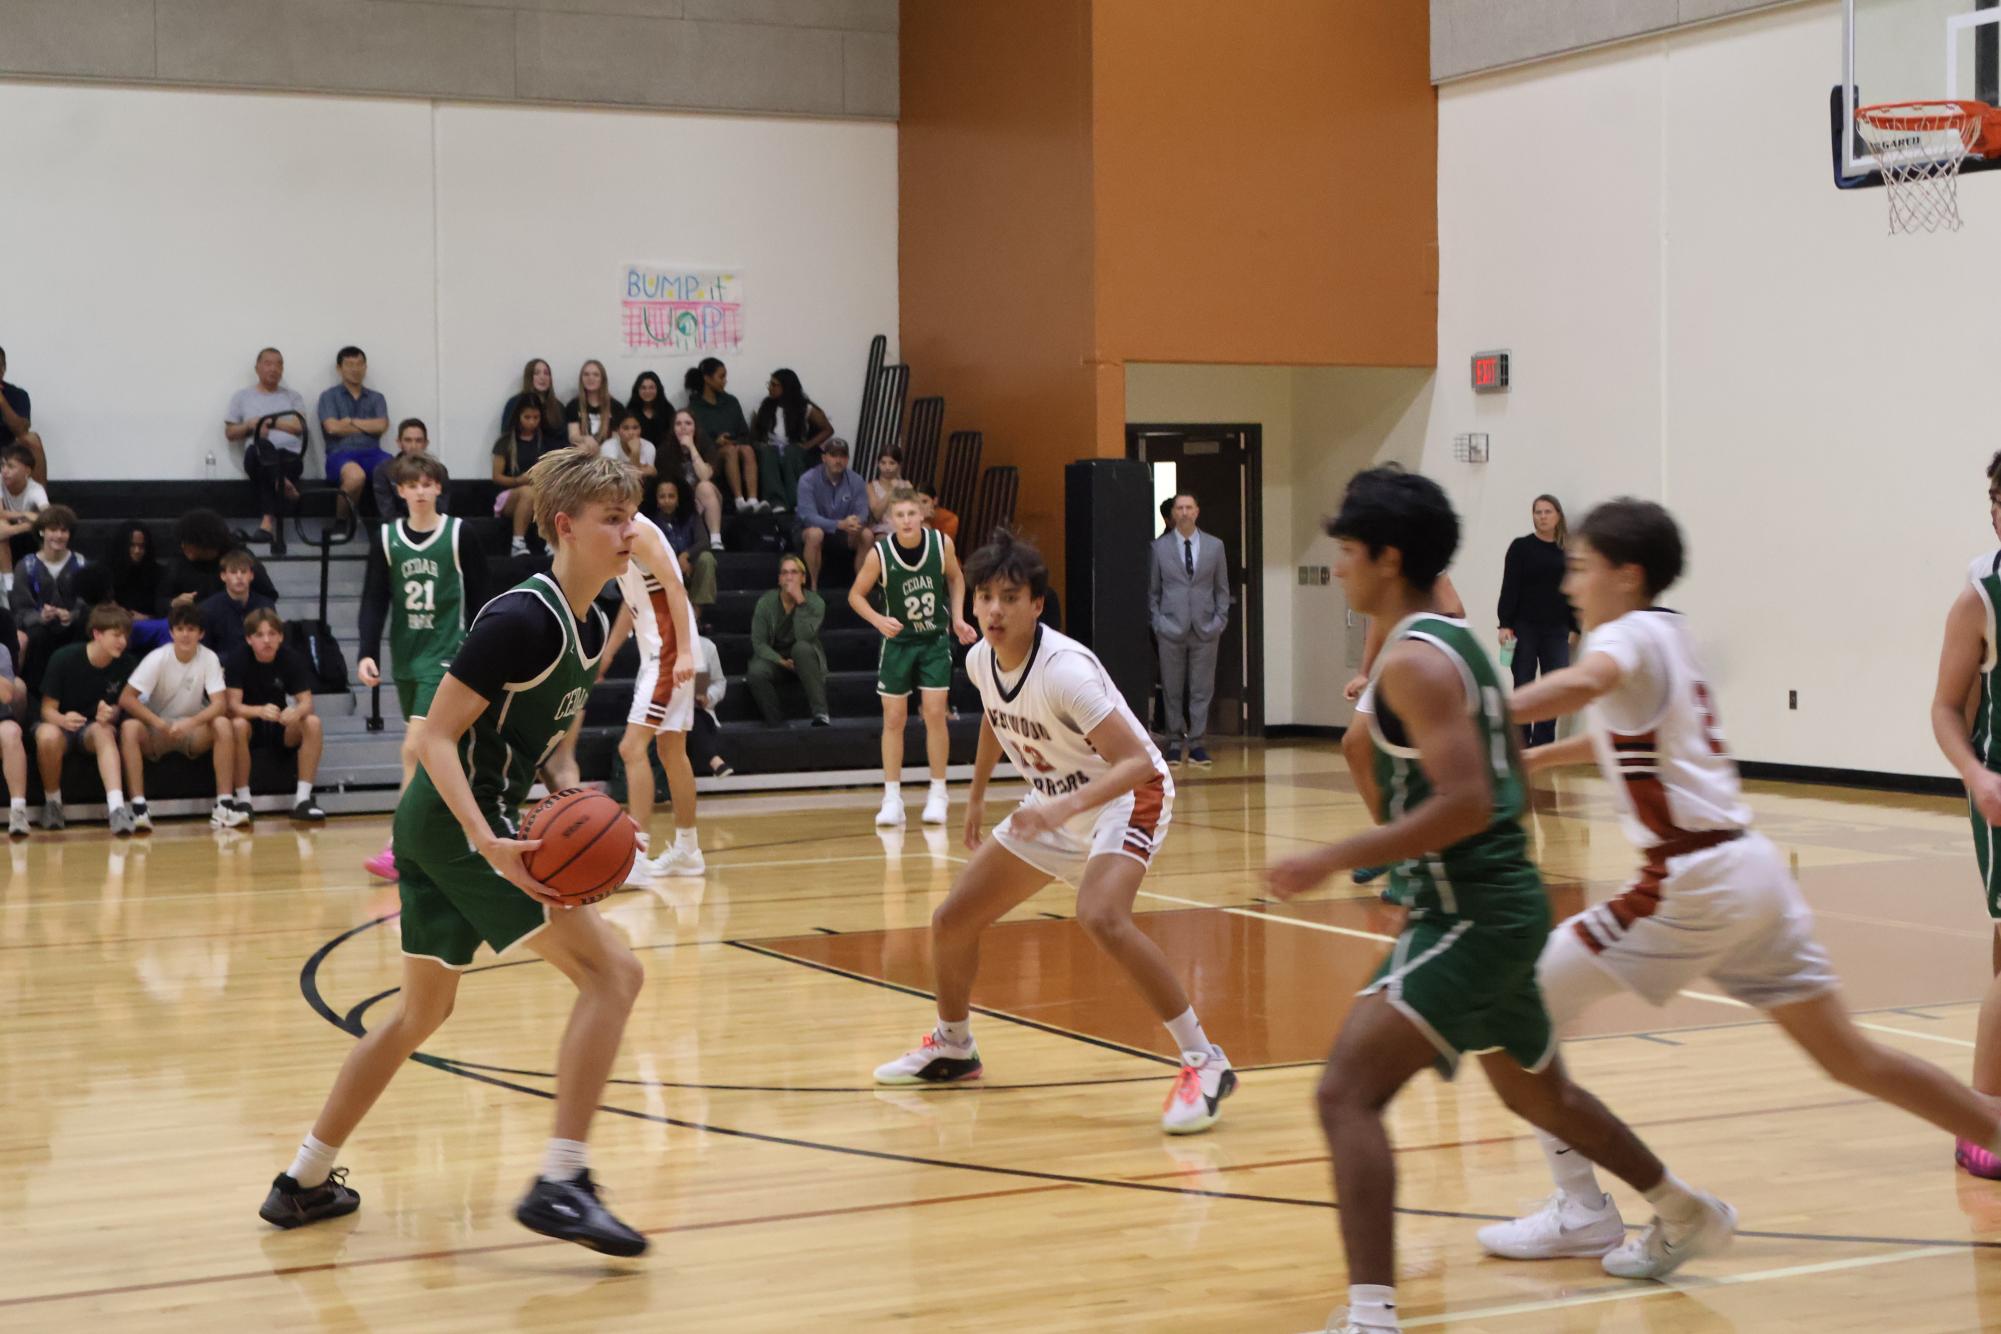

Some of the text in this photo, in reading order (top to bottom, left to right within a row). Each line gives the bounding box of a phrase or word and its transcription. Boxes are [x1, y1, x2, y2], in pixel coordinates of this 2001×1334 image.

[627, 270, 700, 301] BUMP
[404, 580, 435, 611] 21
[902, 576, 934, 595] CEDAR
[904, 592, 936, 621] 23
